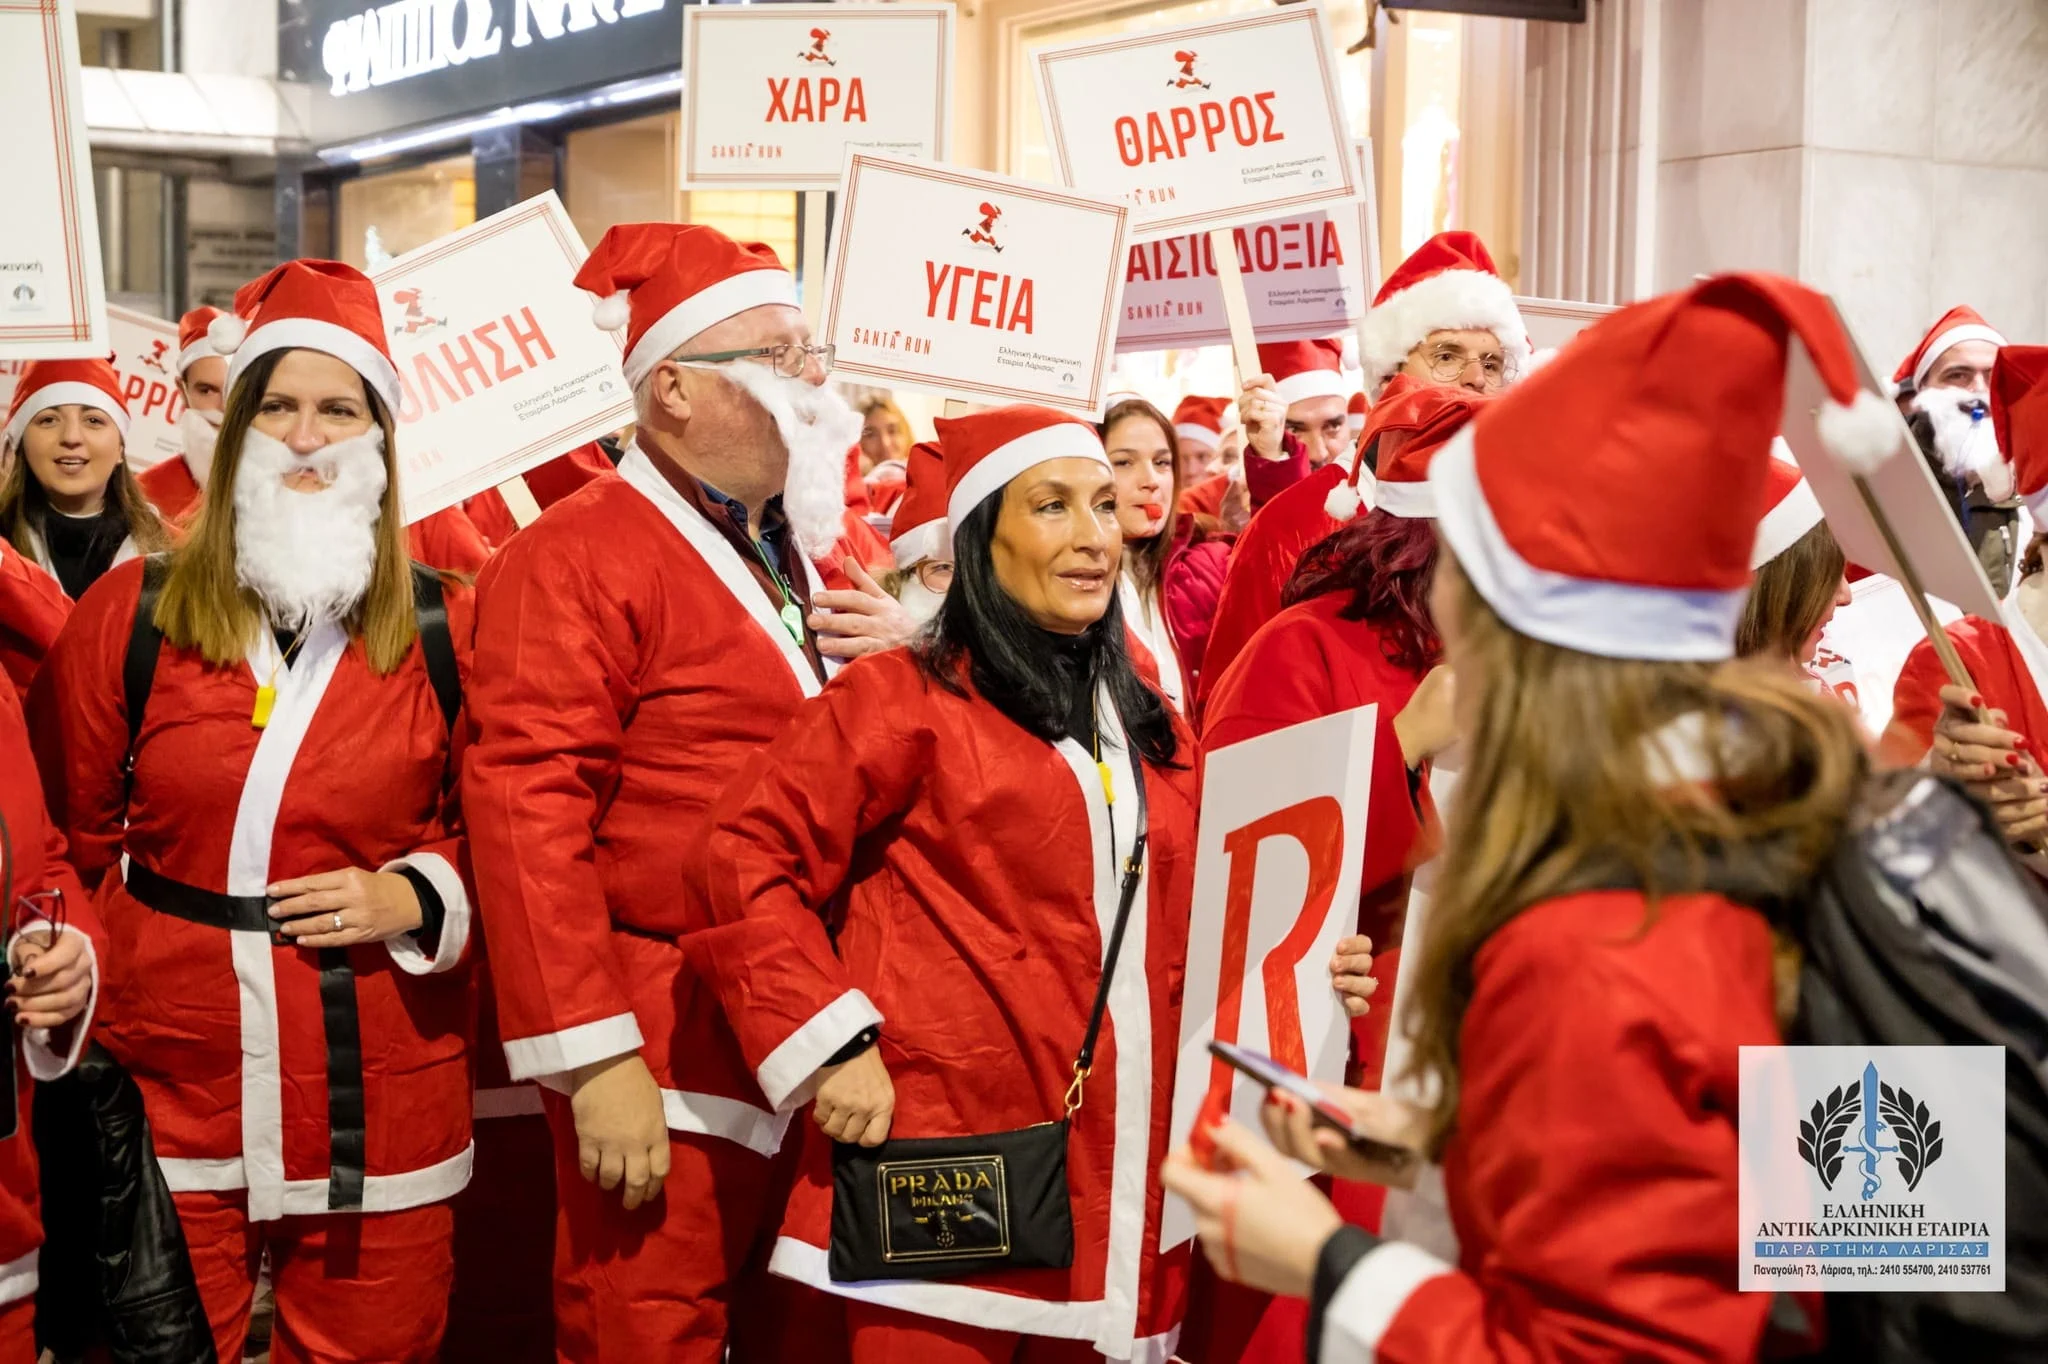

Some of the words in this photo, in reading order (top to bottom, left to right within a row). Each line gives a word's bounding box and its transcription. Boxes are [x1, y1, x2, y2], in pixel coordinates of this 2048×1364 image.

[765, 77, 867, 123] ΧΑΡΑ
[1114, 91, 1285, 167] ΘΑΡΡΟΣ
[711, 143, 753, 158] SANTA
[758, 145, 783, 158] RUN
[1148, 186, 1177, 204] RUN
[926, 261, 1034, 334] ΥΓΕΙΑ
[1127, 304, 1170, 320] SANTA
[1177, 301, 1203, 316] RUN
[853, 328, 897, 350] SANTA
[905, 336, 932, 355] RUN
[891, 1172, 993, 1194] PRADA
[912, 1195, 974, 1208] MILANO
